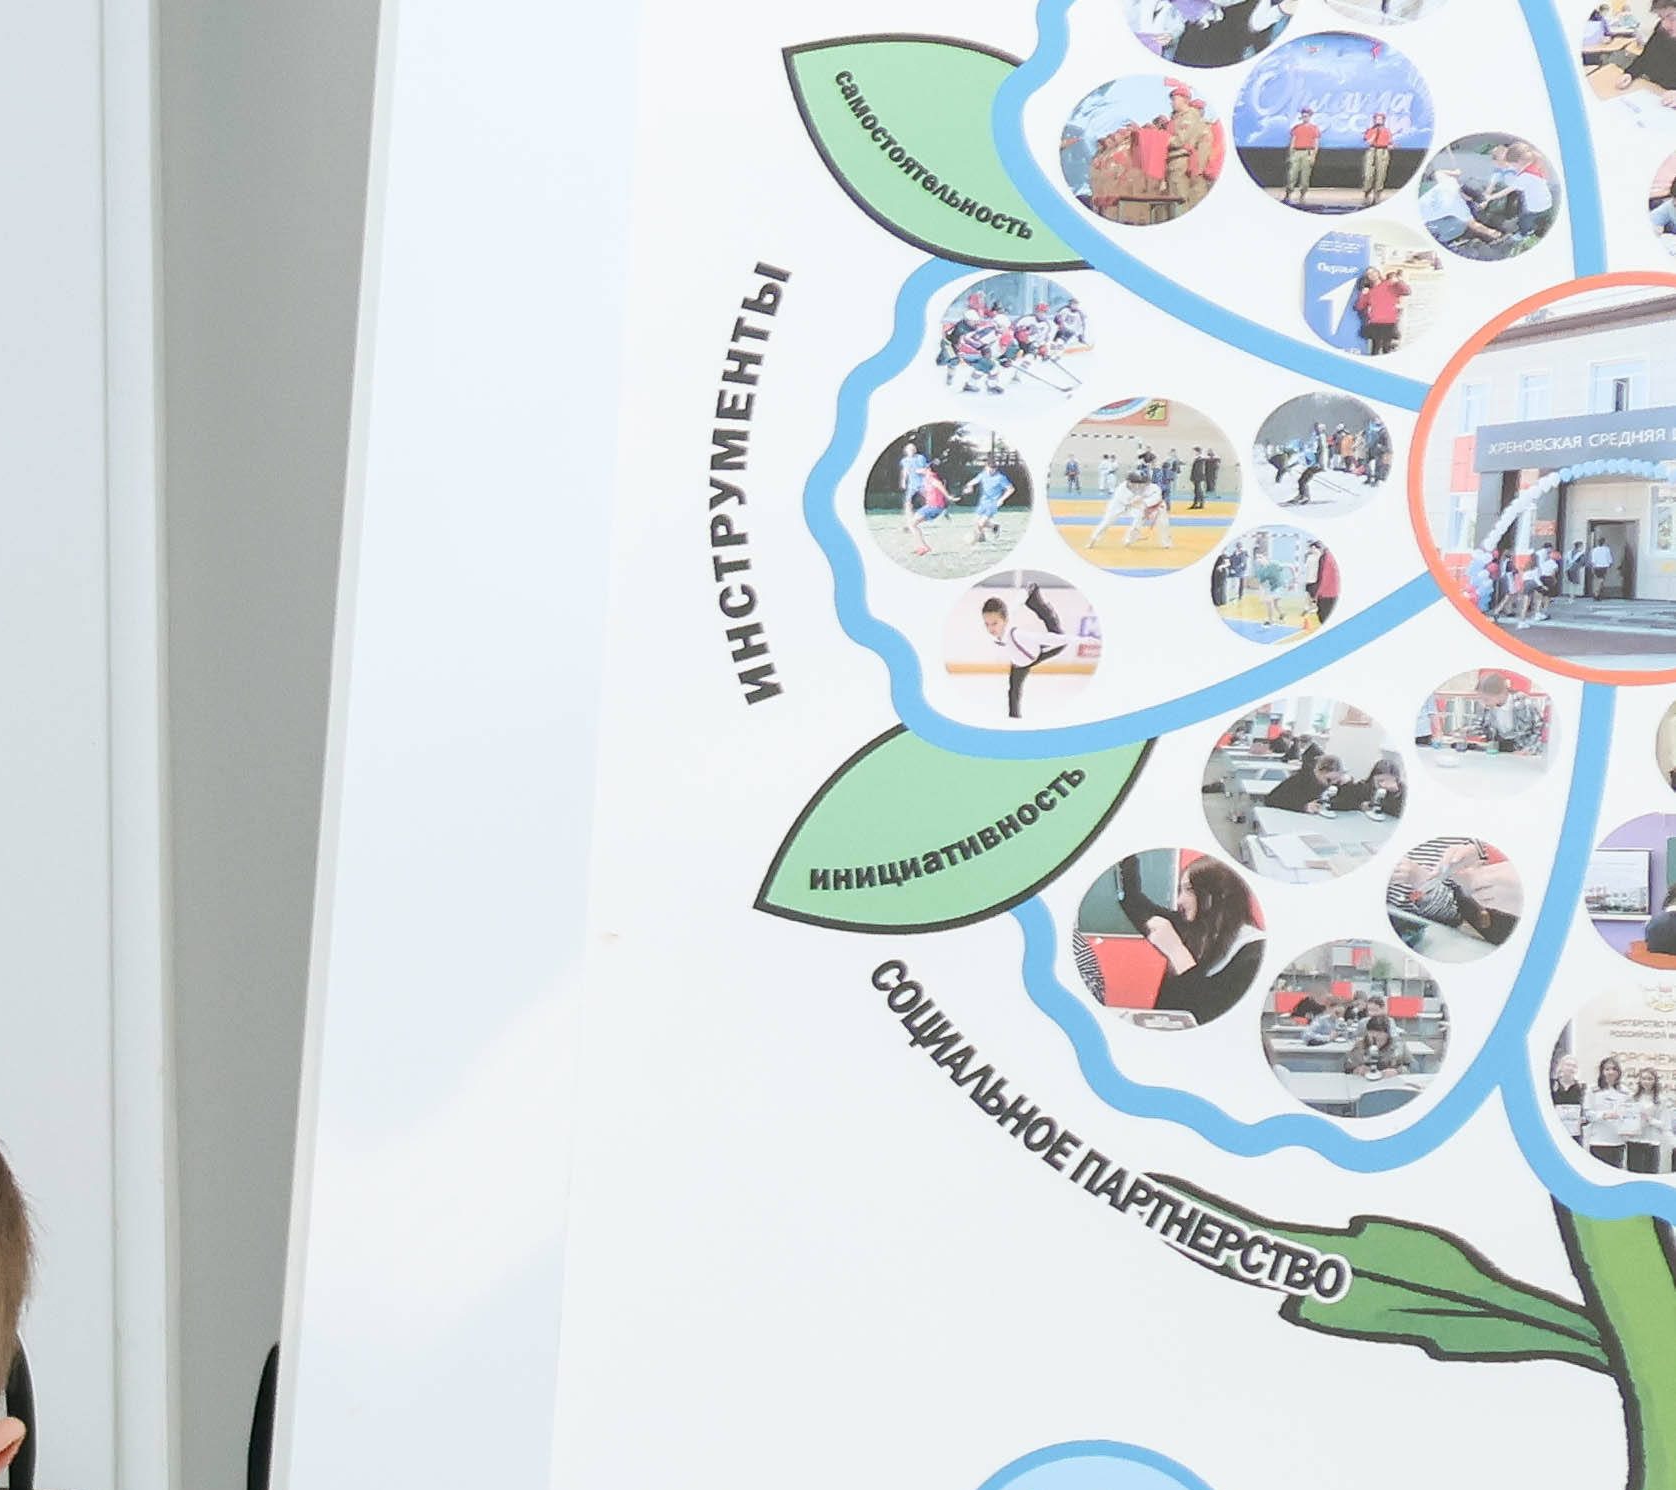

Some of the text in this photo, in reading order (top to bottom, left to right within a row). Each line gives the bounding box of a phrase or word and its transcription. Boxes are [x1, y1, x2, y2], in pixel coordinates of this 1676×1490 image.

[835, 70, 1033, 240] самостоятельность
[709, 261, 793, 706] ИНСТРУМЕНТЫ
[1487, 434, 1583, 456] ХРЕНОВСКАЯ
[1587, 427, 1667, 448] СРЕДНЯЯ
[809, 766, 1087, 891] инициативность
[871, 959, 1347, 1299] СОЦИАЛЬНОЕ ПАРТНЕРСТВО
